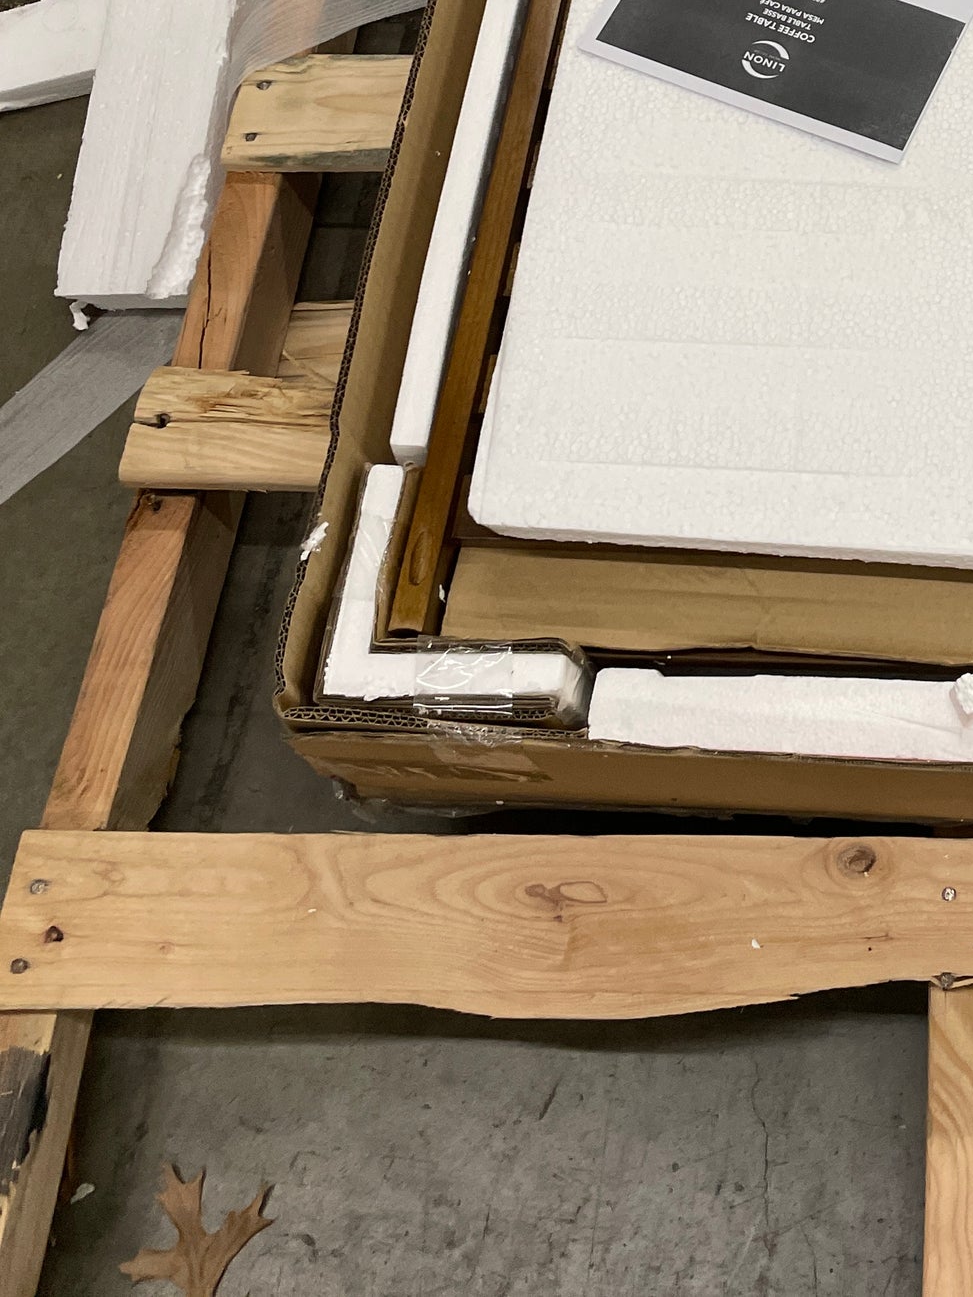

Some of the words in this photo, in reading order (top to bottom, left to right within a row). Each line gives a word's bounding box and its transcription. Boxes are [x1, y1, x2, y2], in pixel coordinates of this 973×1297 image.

[763, 8, 786, 22] BASSE
[781, 4, 802, 16] PARA
[745, 12, 776, 30] TABLE
[787, 16, 811, 30] TABLE
[803, 12, 824, 24] MESA
[778, 24, 816, 43] COFFEE
[744, 51, 785, 72] LINON
